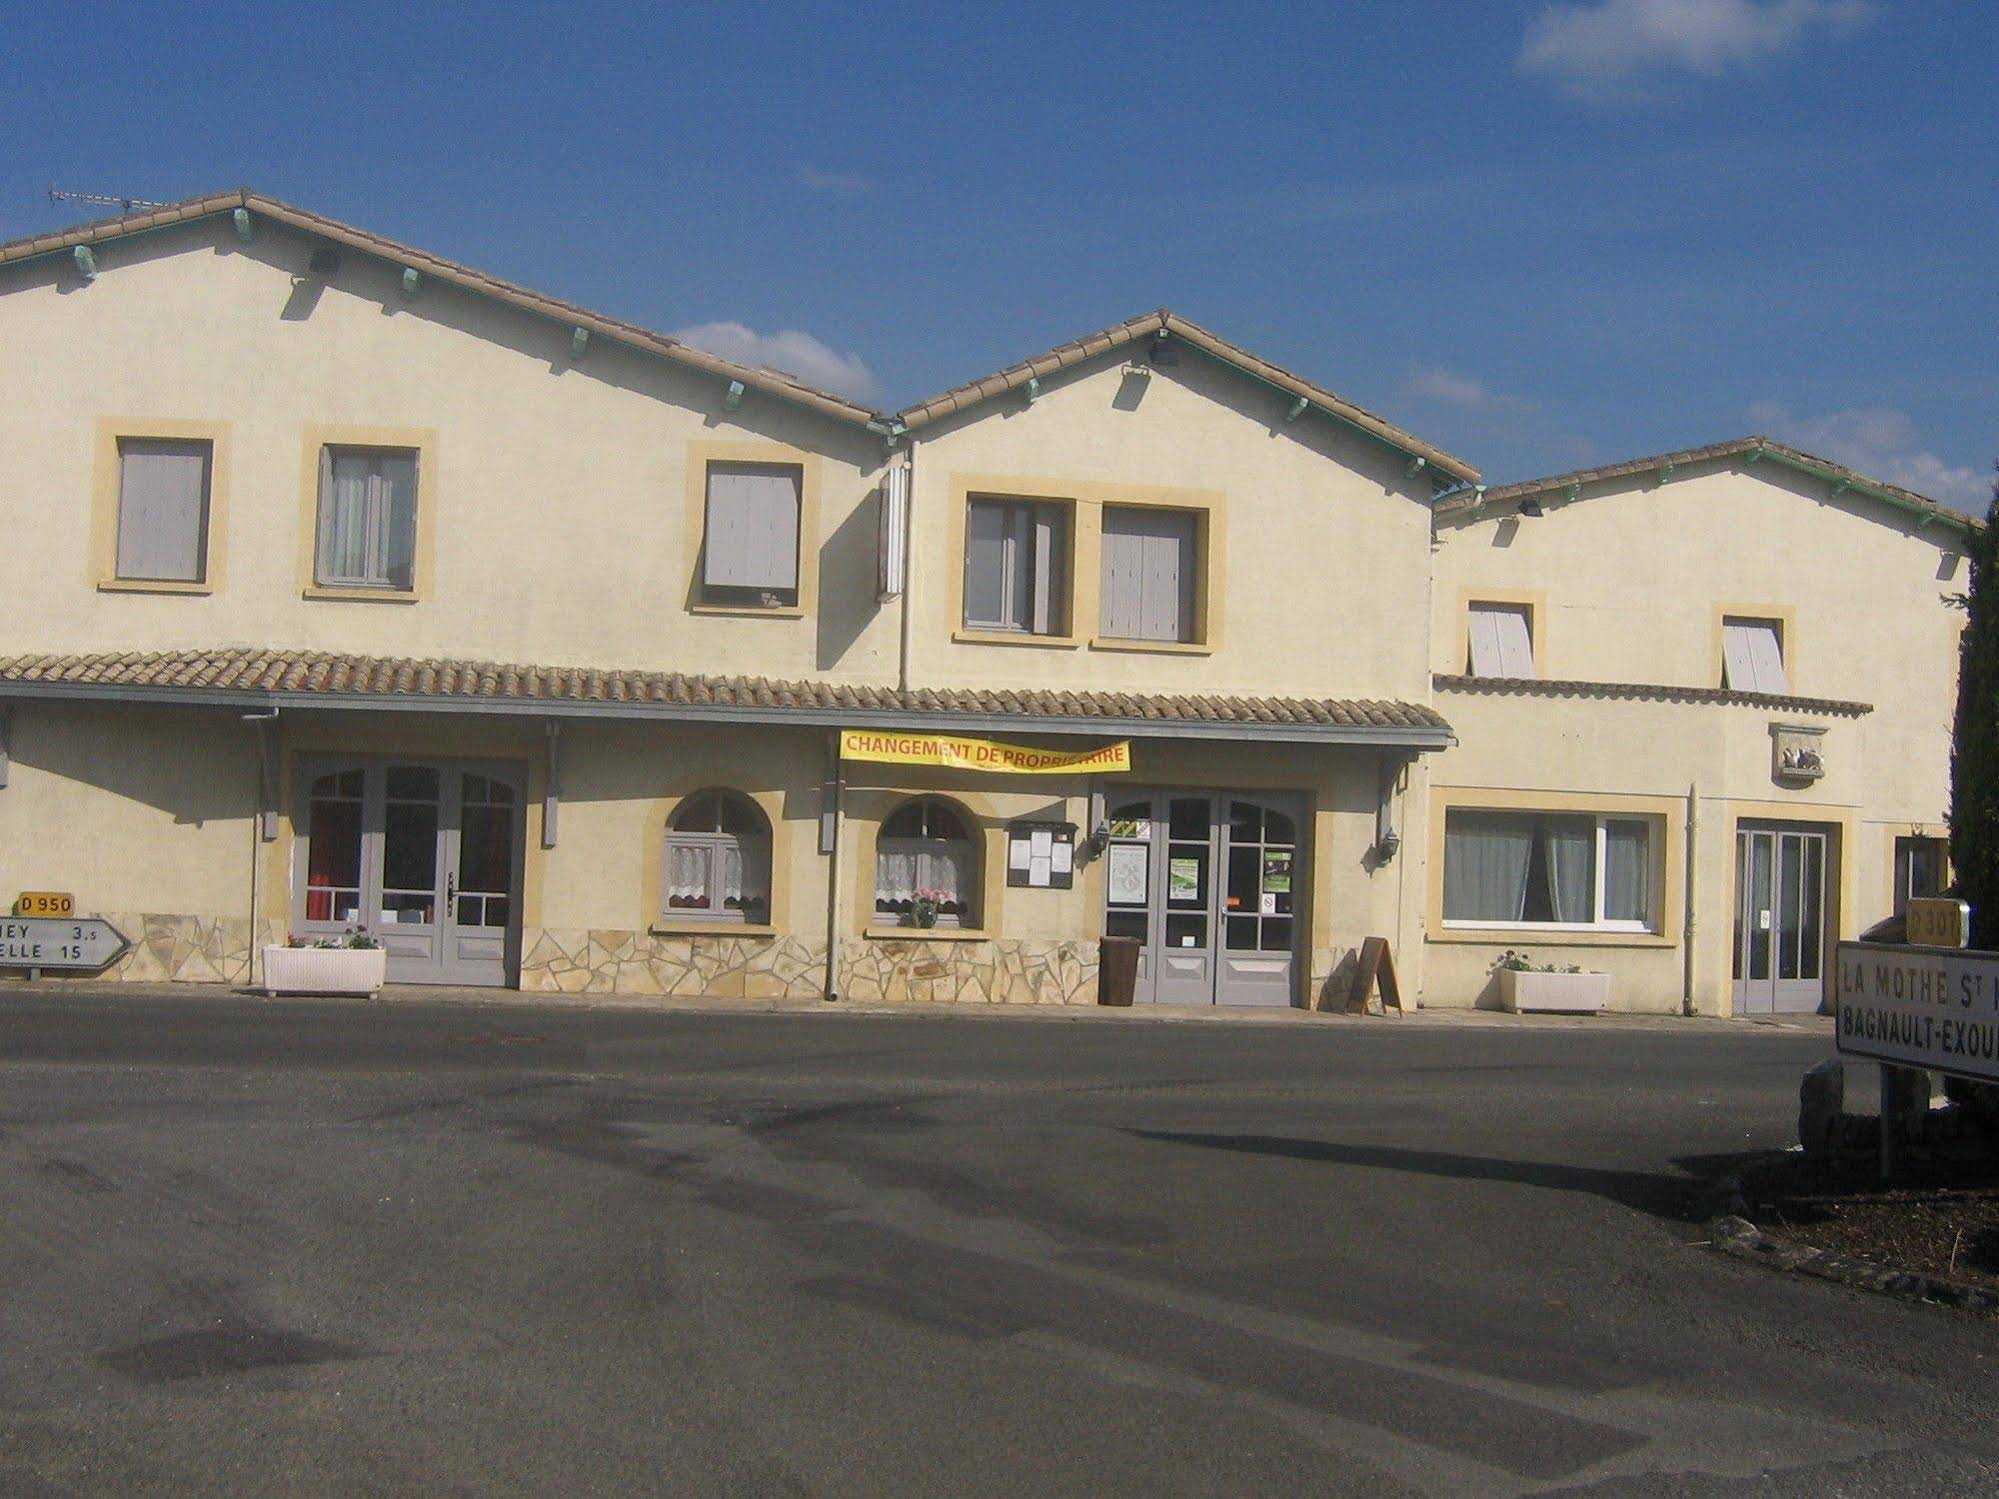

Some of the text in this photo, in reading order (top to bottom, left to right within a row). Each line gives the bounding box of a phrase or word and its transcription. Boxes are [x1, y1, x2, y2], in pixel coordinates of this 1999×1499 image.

[846, 735, 970, 761] CHANGEMENT
[976, 746, 999, 762] DE
[22, 897, 71, 912] D 950
[61, 945, 81, 959] 15
[1843, 962, 1865, 994] LA
[1876, 964, 1947, 1005] MOTHE
[1843, 1005, 1999, 1061] BAGNAULT-EXOU
